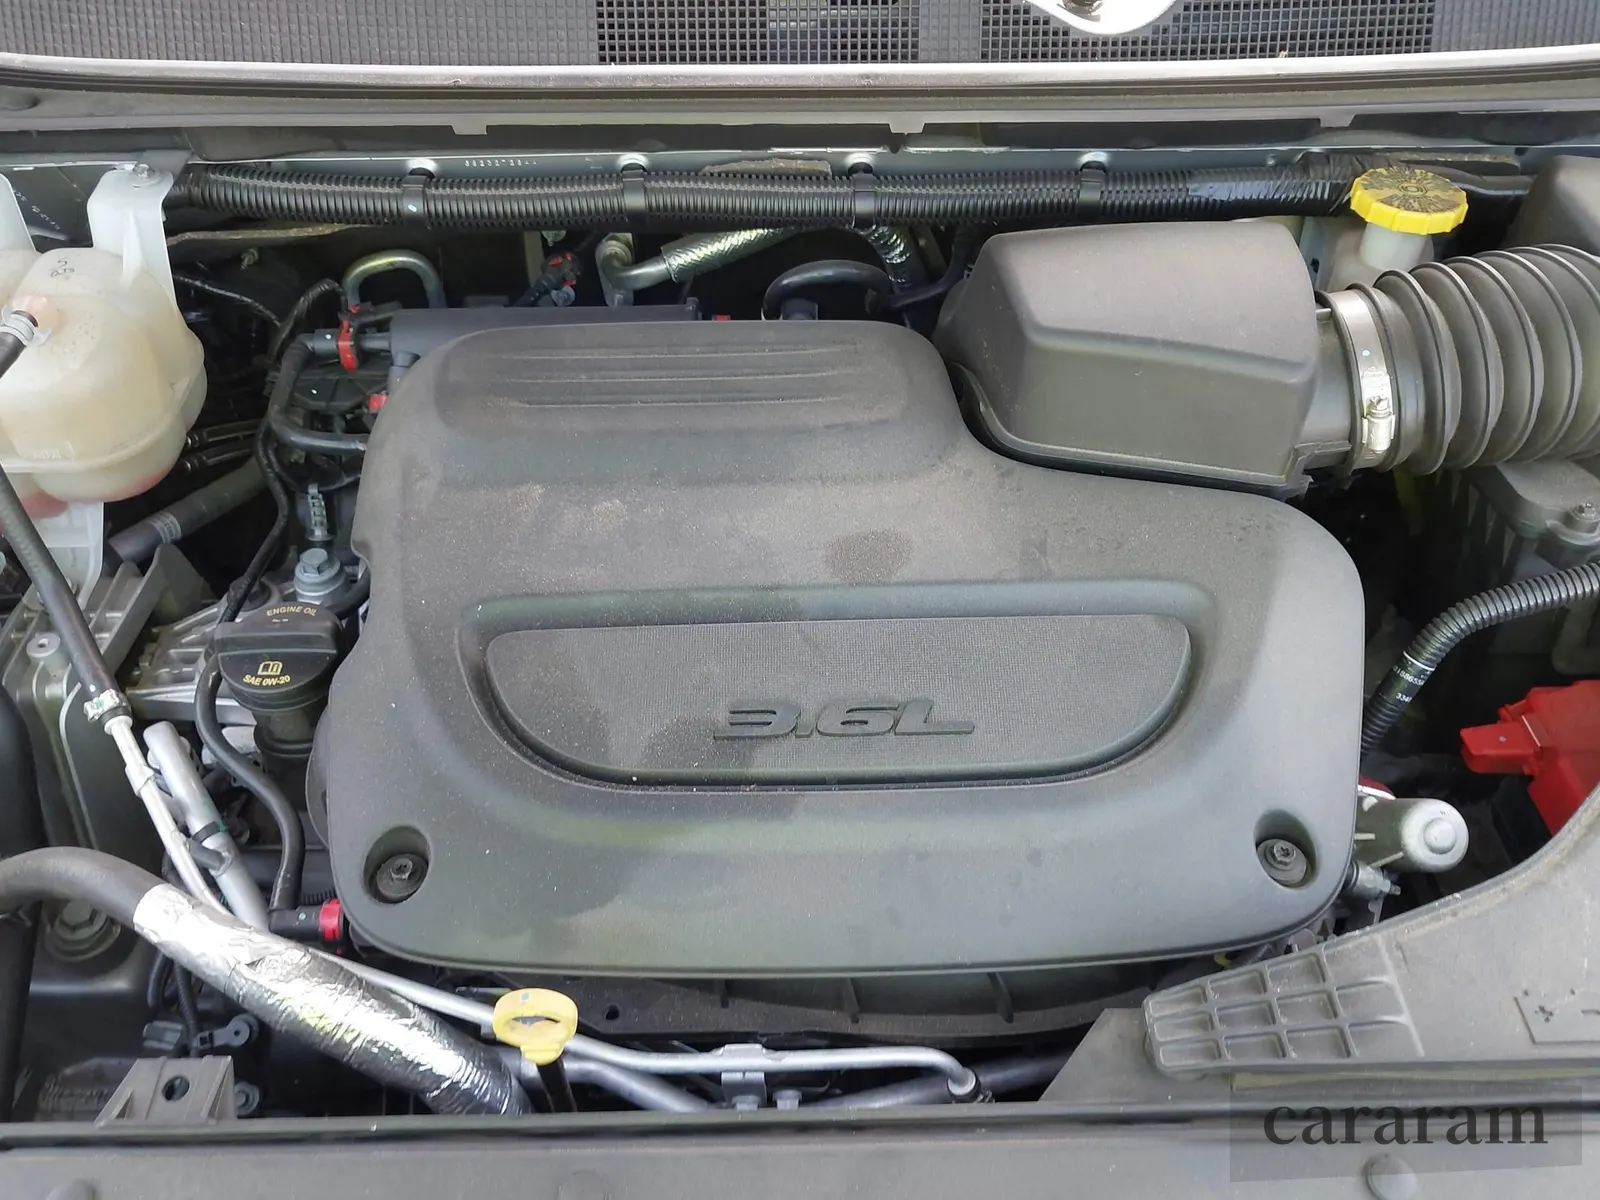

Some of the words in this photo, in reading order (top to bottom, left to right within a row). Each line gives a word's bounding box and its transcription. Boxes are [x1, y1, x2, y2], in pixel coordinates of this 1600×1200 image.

[266, 605, 302, 617] ENGINE
[303, 607, 317, 617] OIL
[243, 674, 262, 686] SAE
[713, 700, 975, 741] 3.6L
